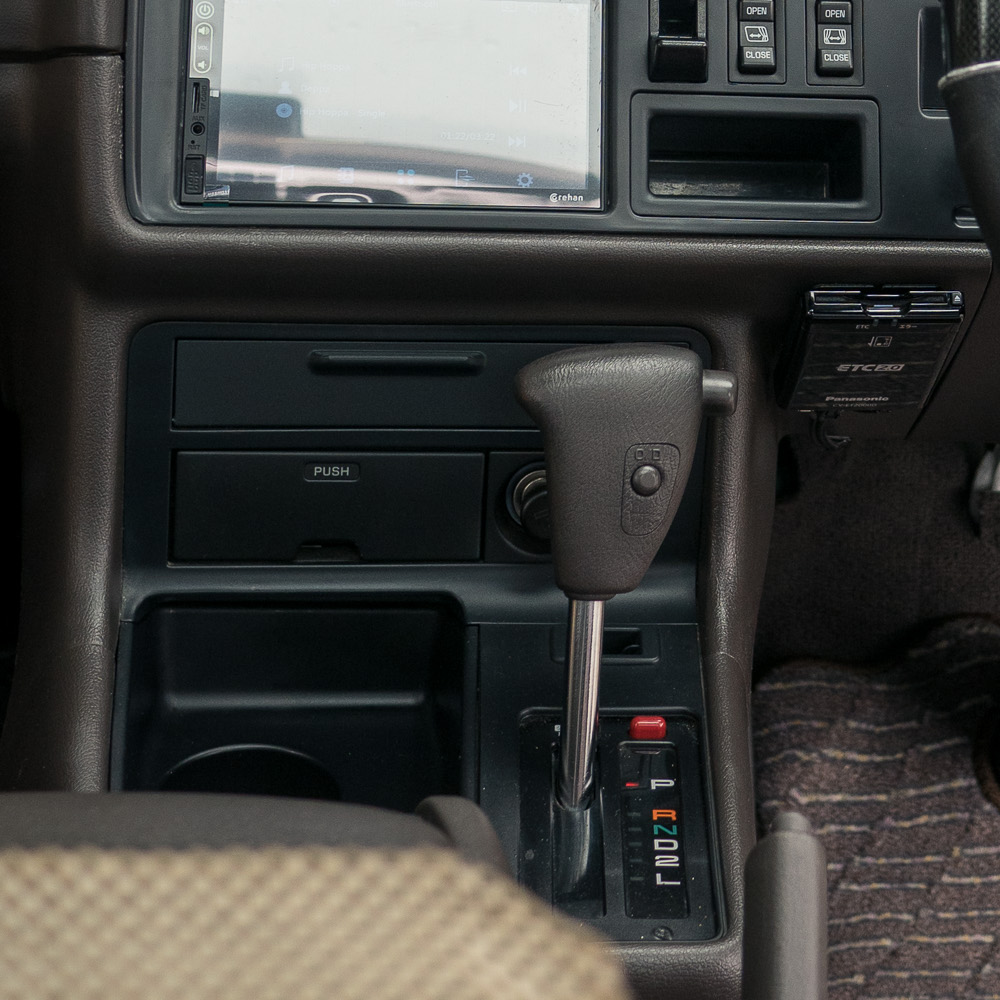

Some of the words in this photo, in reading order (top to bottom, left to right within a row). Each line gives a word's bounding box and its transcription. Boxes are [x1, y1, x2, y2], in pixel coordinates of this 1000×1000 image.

[746, 6, 768, 15] OPEN
[825, 9, 846, 18] OPEN
[745, 51, 771, 59] CLOSE
[824, 53, 849, 62] CLOSE
[314, 466, 350, 477] PUSH
[650, 779, 675, 790] P
[652, 809, 677, 821] R
[653, 824, 678, 836] N
[654, 839, 679, 851] D
[655, 855, 680, 867] 2
[656, 873, 681, 886] L
